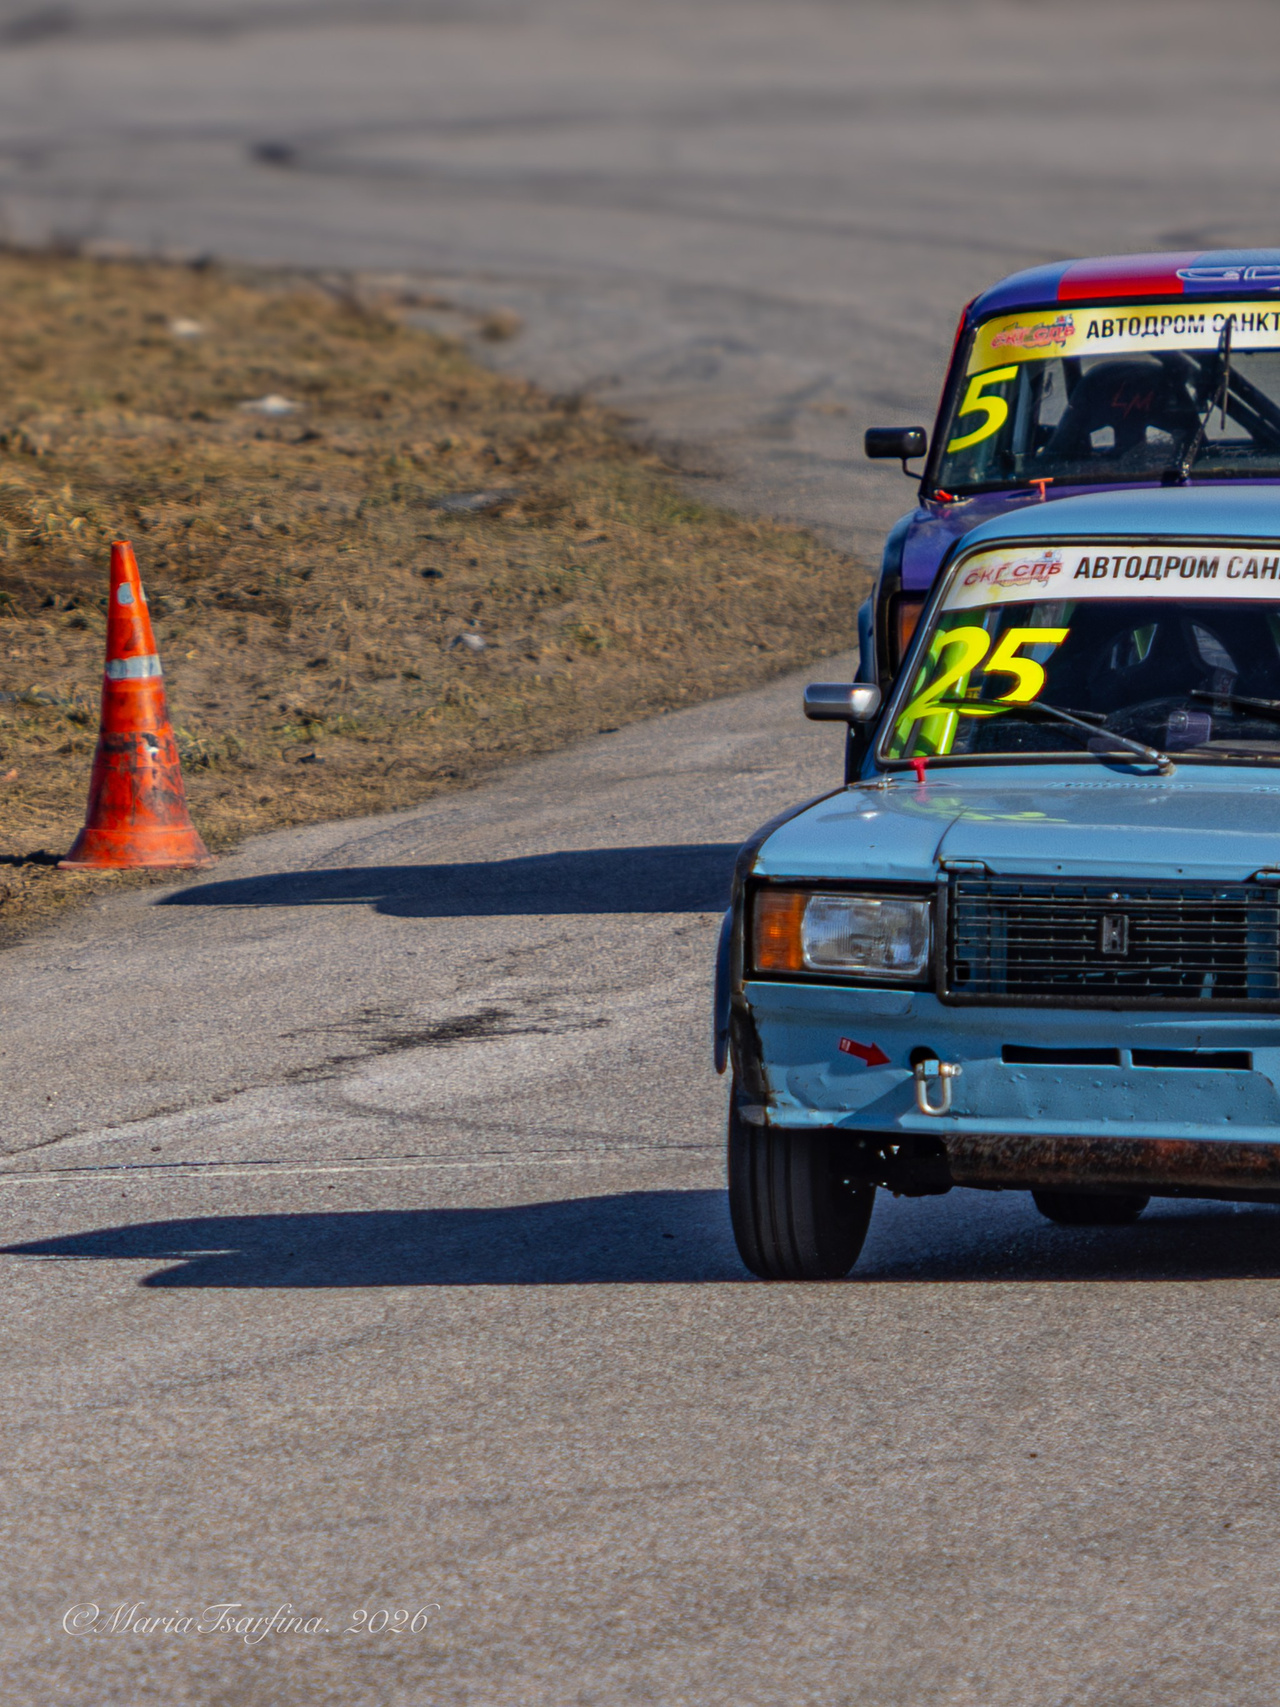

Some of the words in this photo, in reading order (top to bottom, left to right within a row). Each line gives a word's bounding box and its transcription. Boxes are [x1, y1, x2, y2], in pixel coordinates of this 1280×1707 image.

[1086, 313, 1205, 339] АВТОДРОМ
[947, 365, 1019, 454] 5
[963, 565, 1008, 586] СКГ
[1012, 562, 1064, 578] СПБ
[1074, 555, 1220, 582] АВТОДРОМ
[896, 625, 1071, 718] 25
